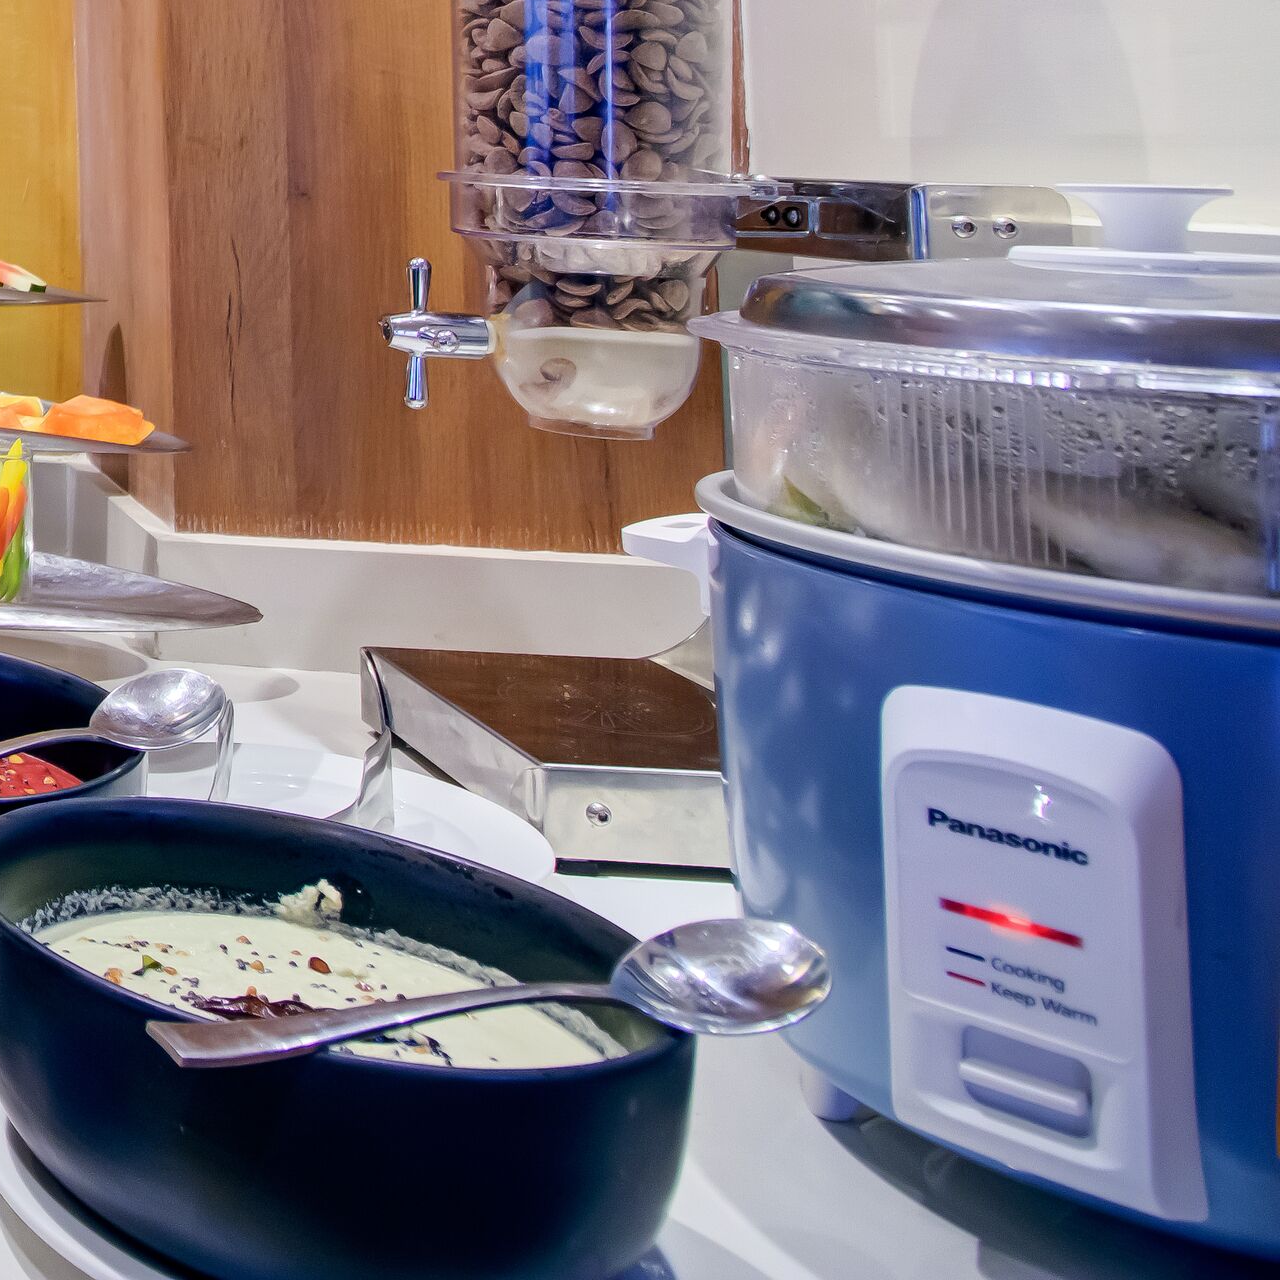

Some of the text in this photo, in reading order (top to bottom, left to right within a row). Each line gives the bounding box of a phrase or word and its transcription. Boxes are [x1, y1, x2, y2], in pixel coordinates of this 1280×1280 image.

[927, 807, 1089, 866] Panasonic
[991, 956, 1065, 993] Cooking
[991, 981, 1098, 1026] Keep Warm
